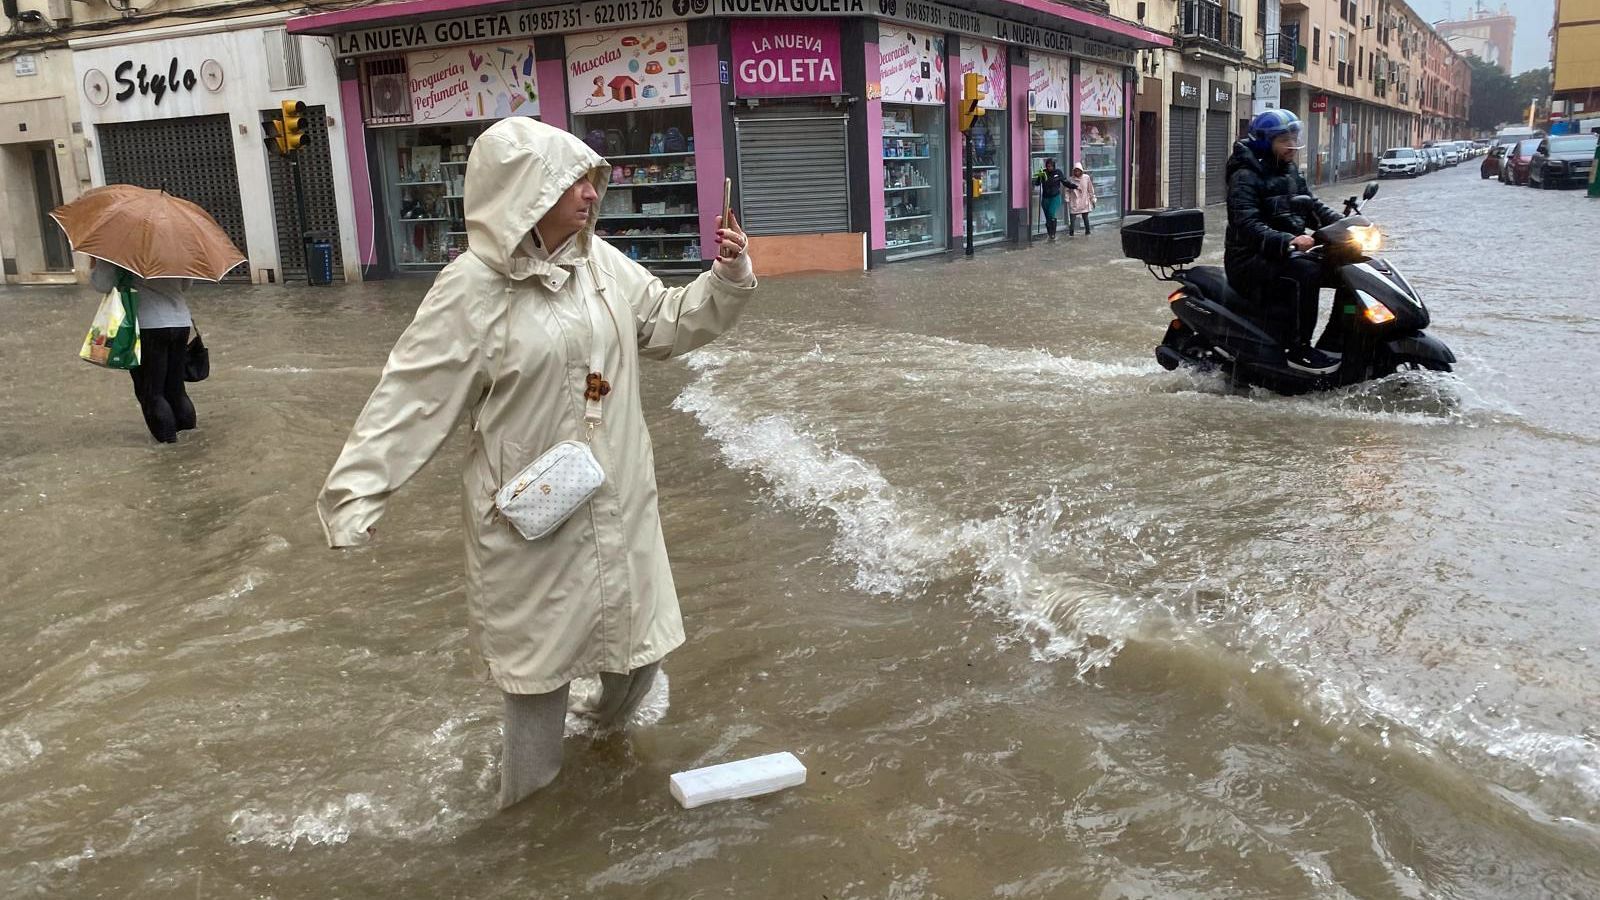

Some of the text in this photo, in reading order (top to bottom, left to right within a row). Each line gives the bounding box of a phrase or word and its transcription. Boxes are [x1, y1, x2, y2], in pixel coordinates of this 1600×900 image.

[722, 0, 863, 12] NUEVA GOLETA
[338, 33, 360, 53] LA
[365, 26, 427, 51] NUEVA
[434, 14, 512, 42] GOLETA
[752, 34, 822, 54] LA NUEVA
[996, 21, 1009, 40] LA
[1013, 25, 1041, 47] NUEVA
[1044, 31, 1073, 52] GOLETA
[571, 48, 622, 77] Mascotas
[739, 58, 836, 83] GOLETA
[115, 57, 197, 106] Stylo
